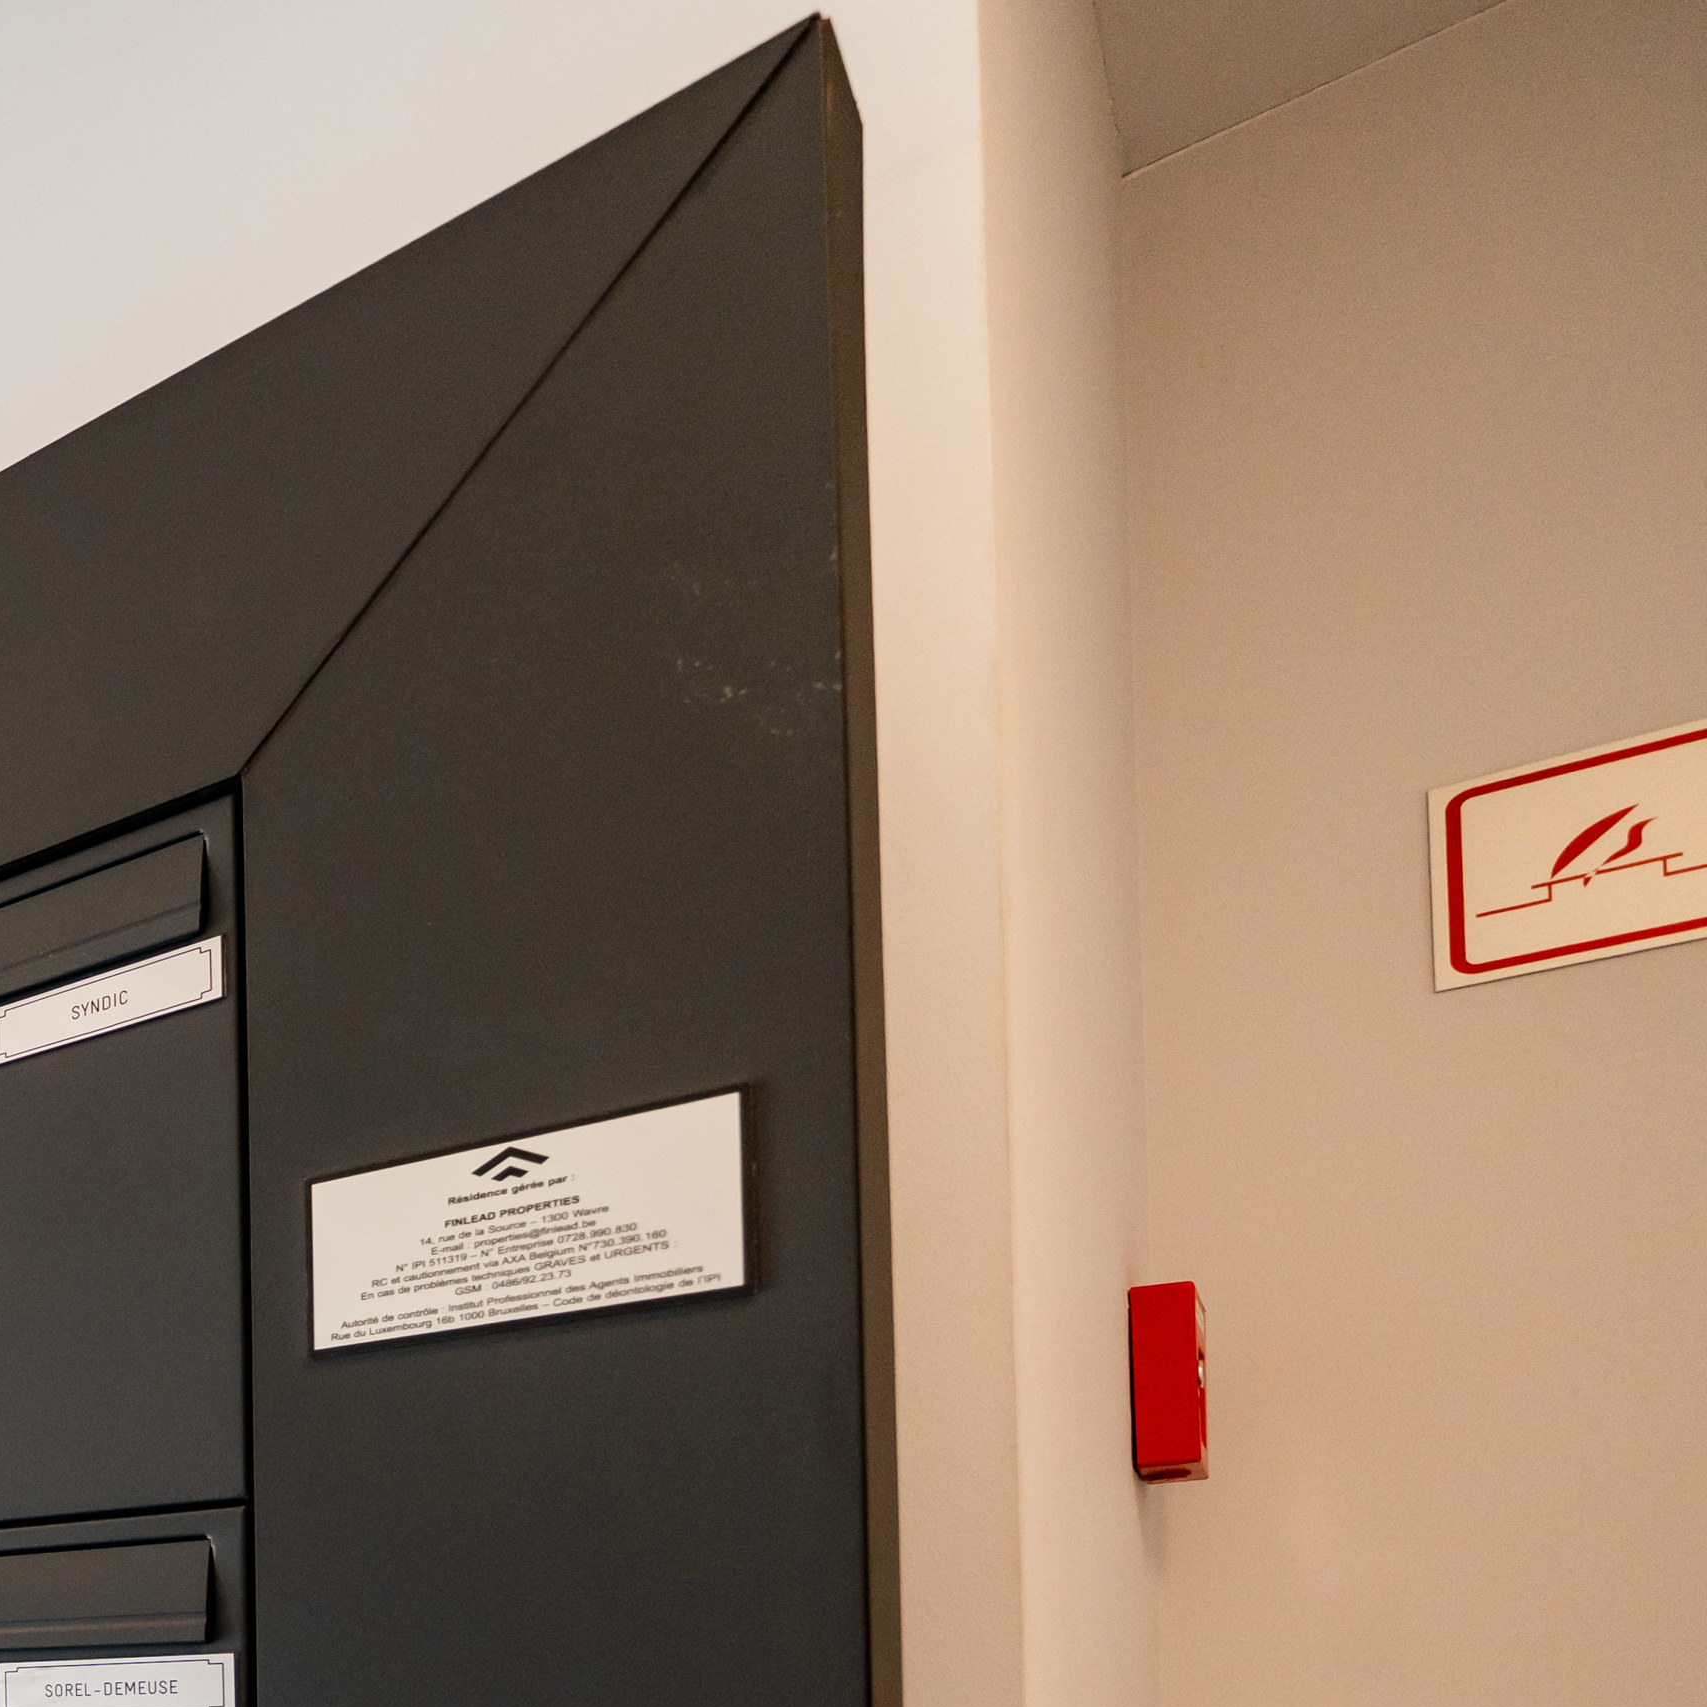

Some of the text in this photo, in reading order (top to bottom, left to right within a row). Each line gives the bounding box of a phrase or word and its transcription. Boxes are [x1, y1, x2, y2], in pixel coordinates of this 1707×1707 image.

[71, 990, 128, 1020] SYNDIC
[448, 1188, 508, 1205] Résidence
[512, 1180, 545, 1196] gérée
[548, 1176, 568, 1188] par
[439, 1233, 456, 1244] rue
[458, 1229, 472, 1240] de
[475, 1227, 485, 1237] la
[488, 1219, 527, 1234] Source
[542, 1211, 568, 1225] 1300
[572, 1205, 610, 1220] Wavre
[445, 1195, 580, 1228] FINLEAD PROPERTIES
[412, 1259, 426, 1270] IPI
[429, 1252, 466, 1268] 511319
[497, 1237, 554, 1255] Entreprise
[431, 1242, 464, 1256] E-mail
[361, 1291, 374, 1301] En
[377, 1288, 395, 1299] cas
[398, 1284, 411, 1294] de
[414, 1276, 468, 1293] problèmes
[472, 1263, 531, 1282] techniques
[534, 1254, 587, 1272] GRAVES
[590, 1252, 601, 1262] et
[604, 1240, 670, 1260] URGENTS
[372, 1277, 388, 1288] RC
[391, 1276, 401, 1286] et
[403, 1262, 480, 1283] cautionnement
[484, 1258, 498, 1269] via
[501, 1253, 526, 1267] AXA
[529, 1245, 575, 1264] Belgium
[341, 1315, 380, 1330] Autorité
[382, 1312, 395, 1323] de
[397, 1306, 439, 1321] contrôle
[449, 1299, 484, 1312] Institut
[487, 1286, 562, 1306] Professionnel
[565, 1282, 586, 1294] des
[588, 1275, 630, 1291] Agents
[633, 1264, 704, 1283] Immobiliers
[455, 1284, 482, 1297] GSM
[331, 1331, 351, 1341] Rue
[354, 1329, 366, 1339] du
[369, 1318, 432, 1336] Luxembourg
[437, 1314, 455, 1325] 16b
[459, 1309, 484, 1321] 1000
[488, 1302, 538, 1317] Bruxelles
[553, 1295, 584, 1307] Code
[587, 1291, 601, 1302] de
[605, 1281, 675, 1300] déontologie
[678, 1277, 692, 1288] de
[44, 1680, 179, 1698] SOREL-DEMEUSE
